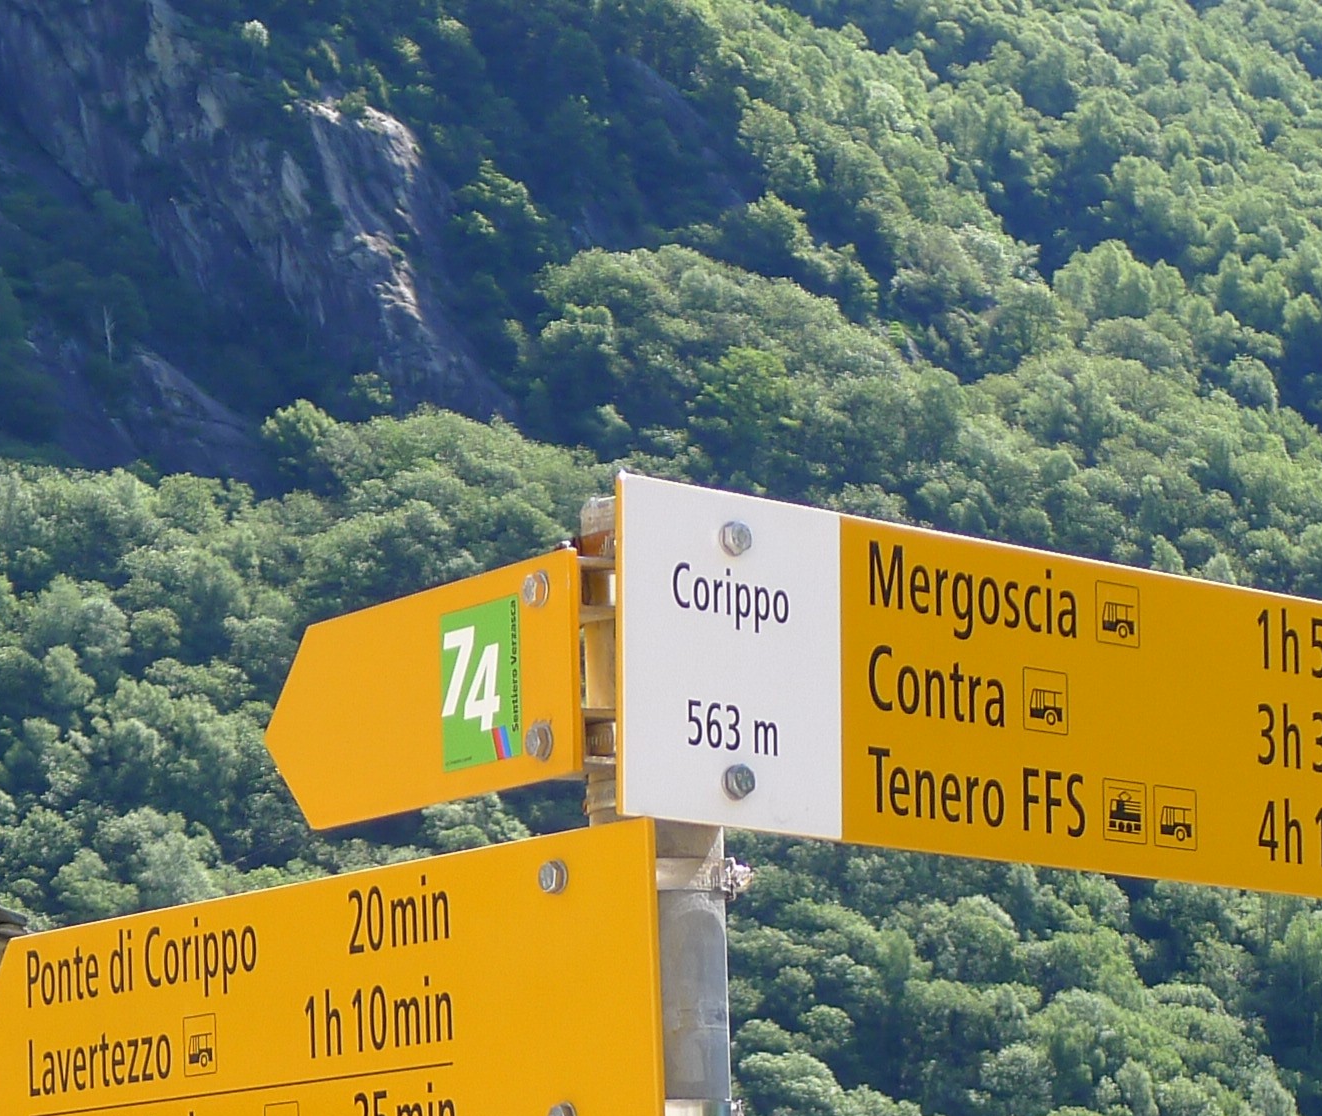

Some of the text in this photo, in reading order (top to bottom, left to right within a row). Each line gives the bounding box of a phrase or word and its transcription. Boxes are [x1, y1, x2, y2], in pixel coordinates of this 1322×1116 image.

[672, 562, 789, 634] Corippo
[868, 540, 1077, 641] Mergoscia
[441, 625, 500, 732] 74
[509, 600, 519, 732] Sentiero Verzasca
[868, 644, 1005, 728] Contra
[688, 699, 778, 757] 563 m
[867, 745, 1086, 838] Tenero FFS
[26, 916, 257, 1008] Ponte di Corippo
[28, 1033, 171, 1097] Lavertezzo
